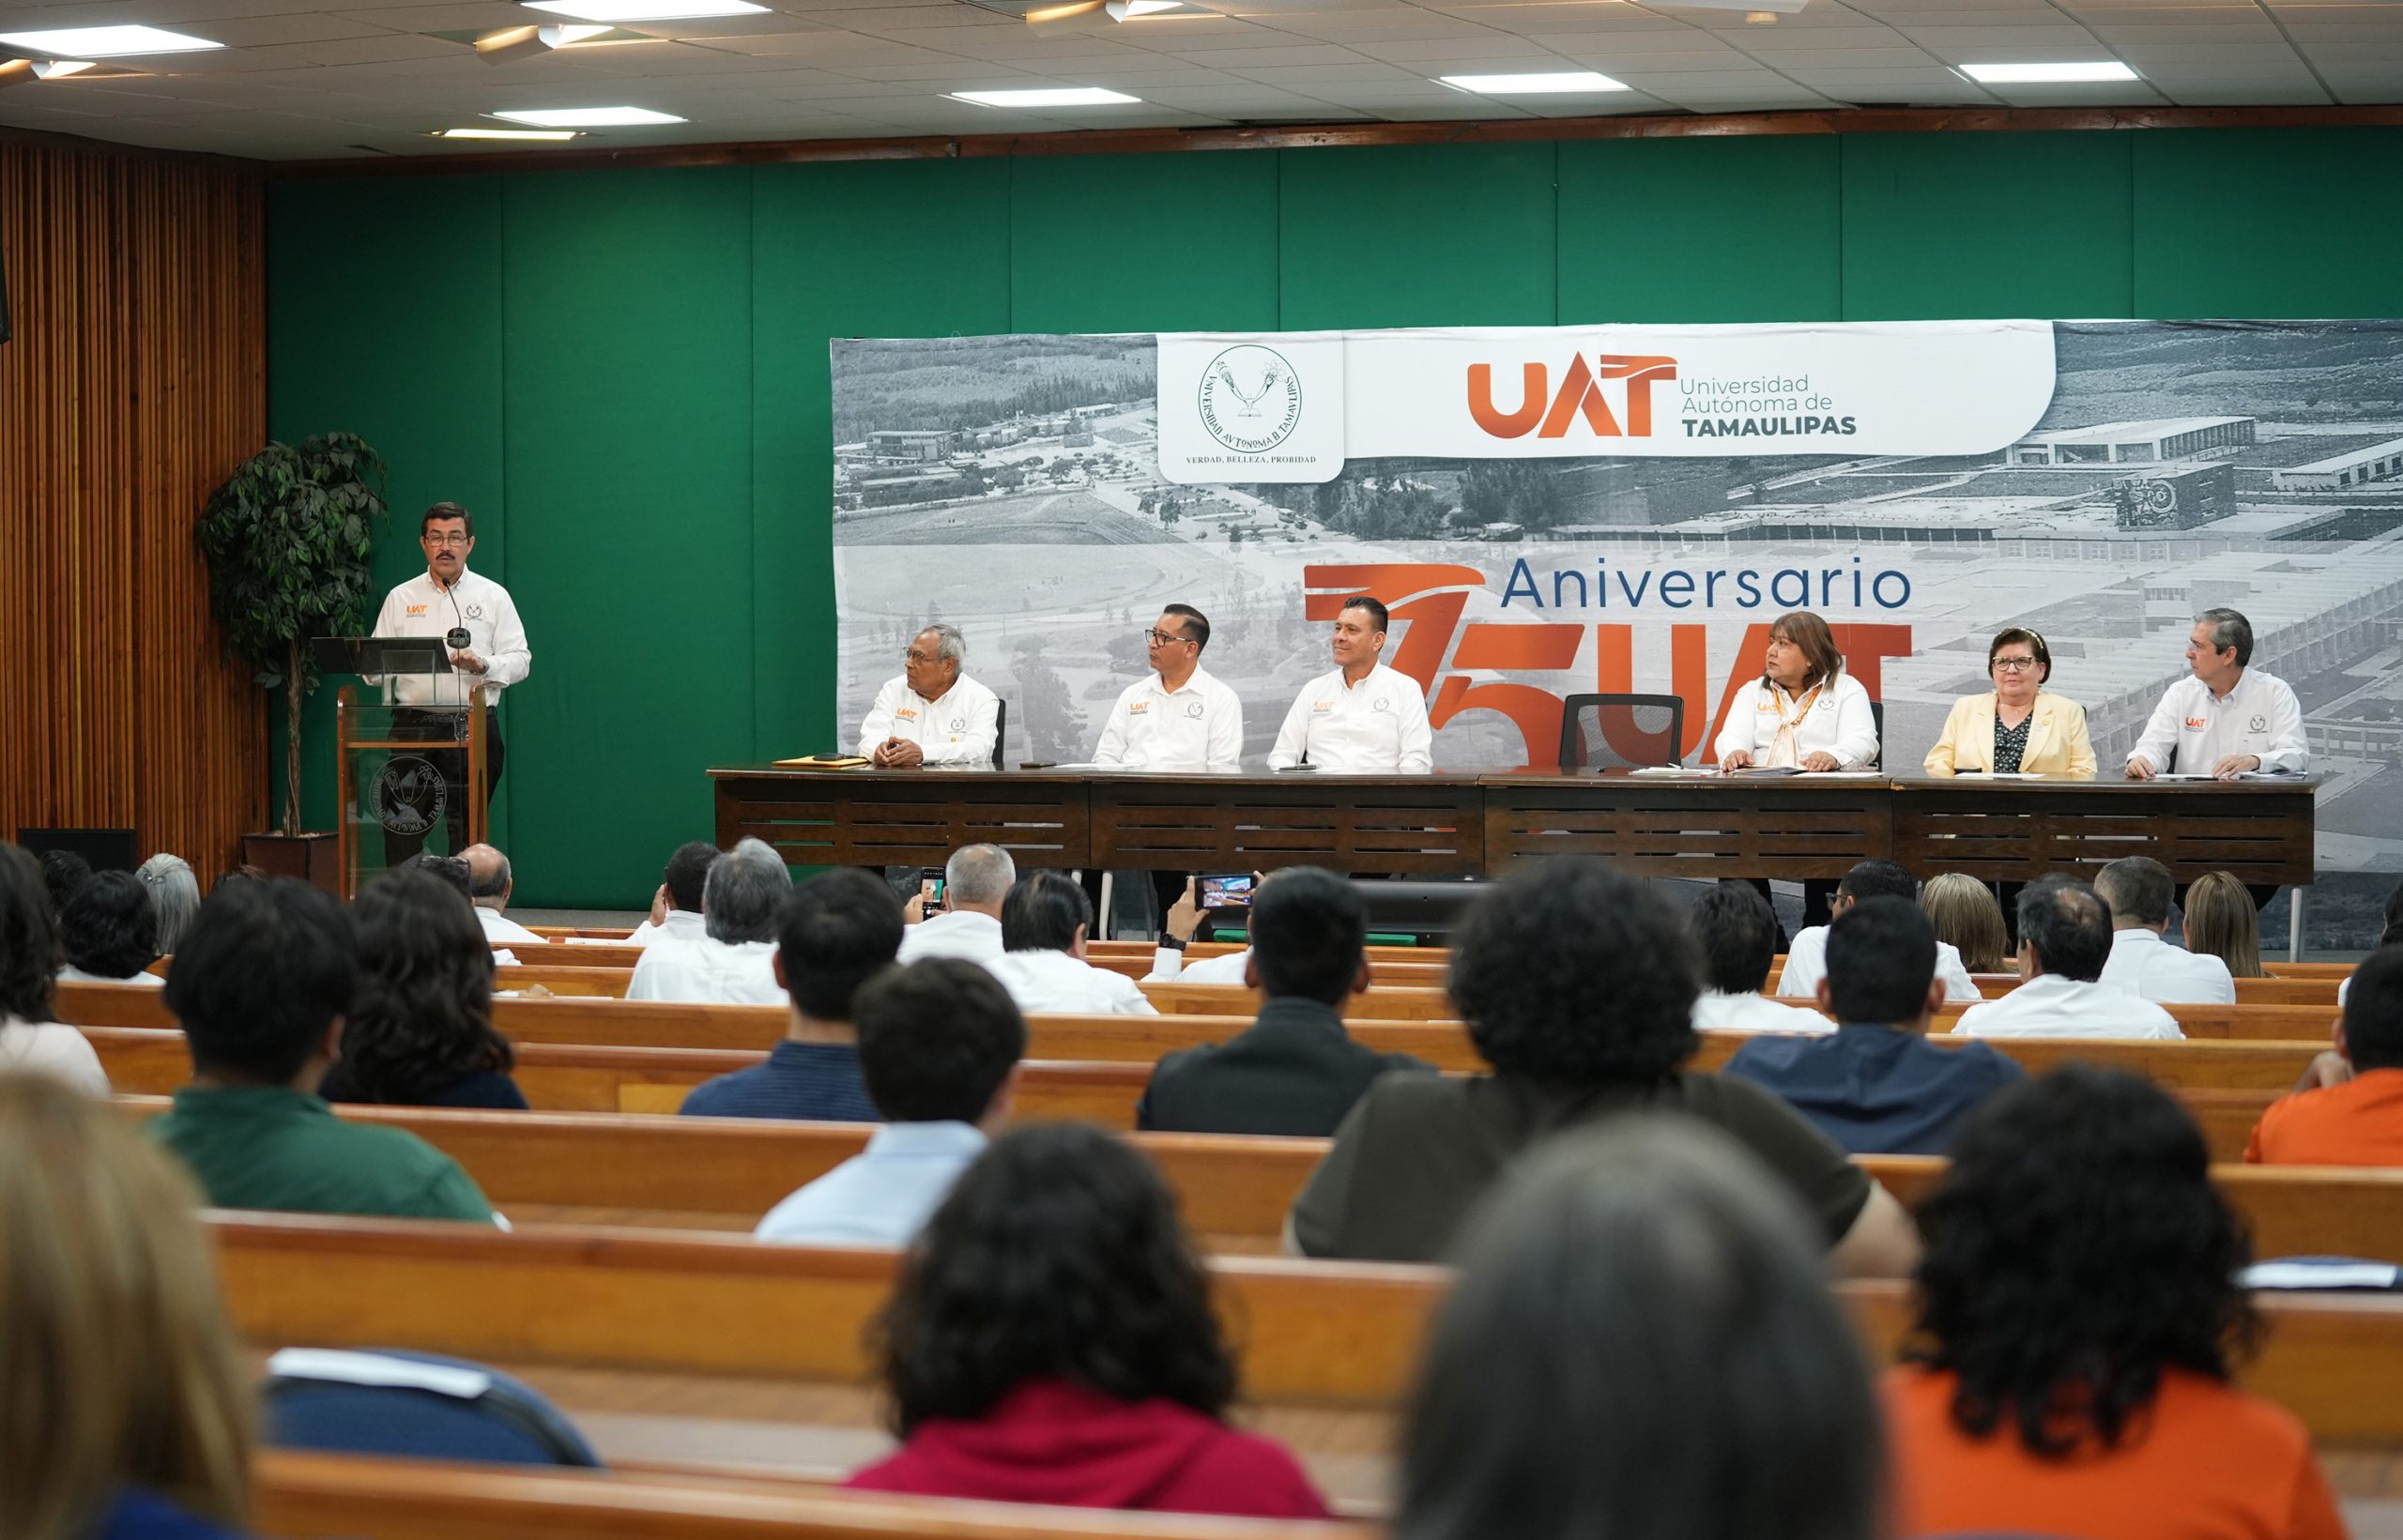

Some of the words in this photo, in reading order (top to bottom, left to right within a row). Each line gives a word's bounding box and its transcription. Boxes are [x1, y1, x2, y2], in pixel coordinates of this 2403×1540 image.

[1467, 351, 1677, 439] UAT
[1680, 374, 1809, 395] Universidad
[1681, 395, 1798, 414] Autónoma
[1804, 392, 1832, 410] de
[1681, 416, 1857, 437] TAMAULIPAS
[1186, 456, 1225, 465] VERDAD,
[1226, 455, 1269, 464] BELLEZA,
[1271, 455, 1316, 464] PROBIDAD
[1500, 557, 1911, 609] Aniversario
[406, 604, 427, 614] UAT
[1130, 702, 1150, 710] UAT
[2185, 716, 2206, 727] UAT
